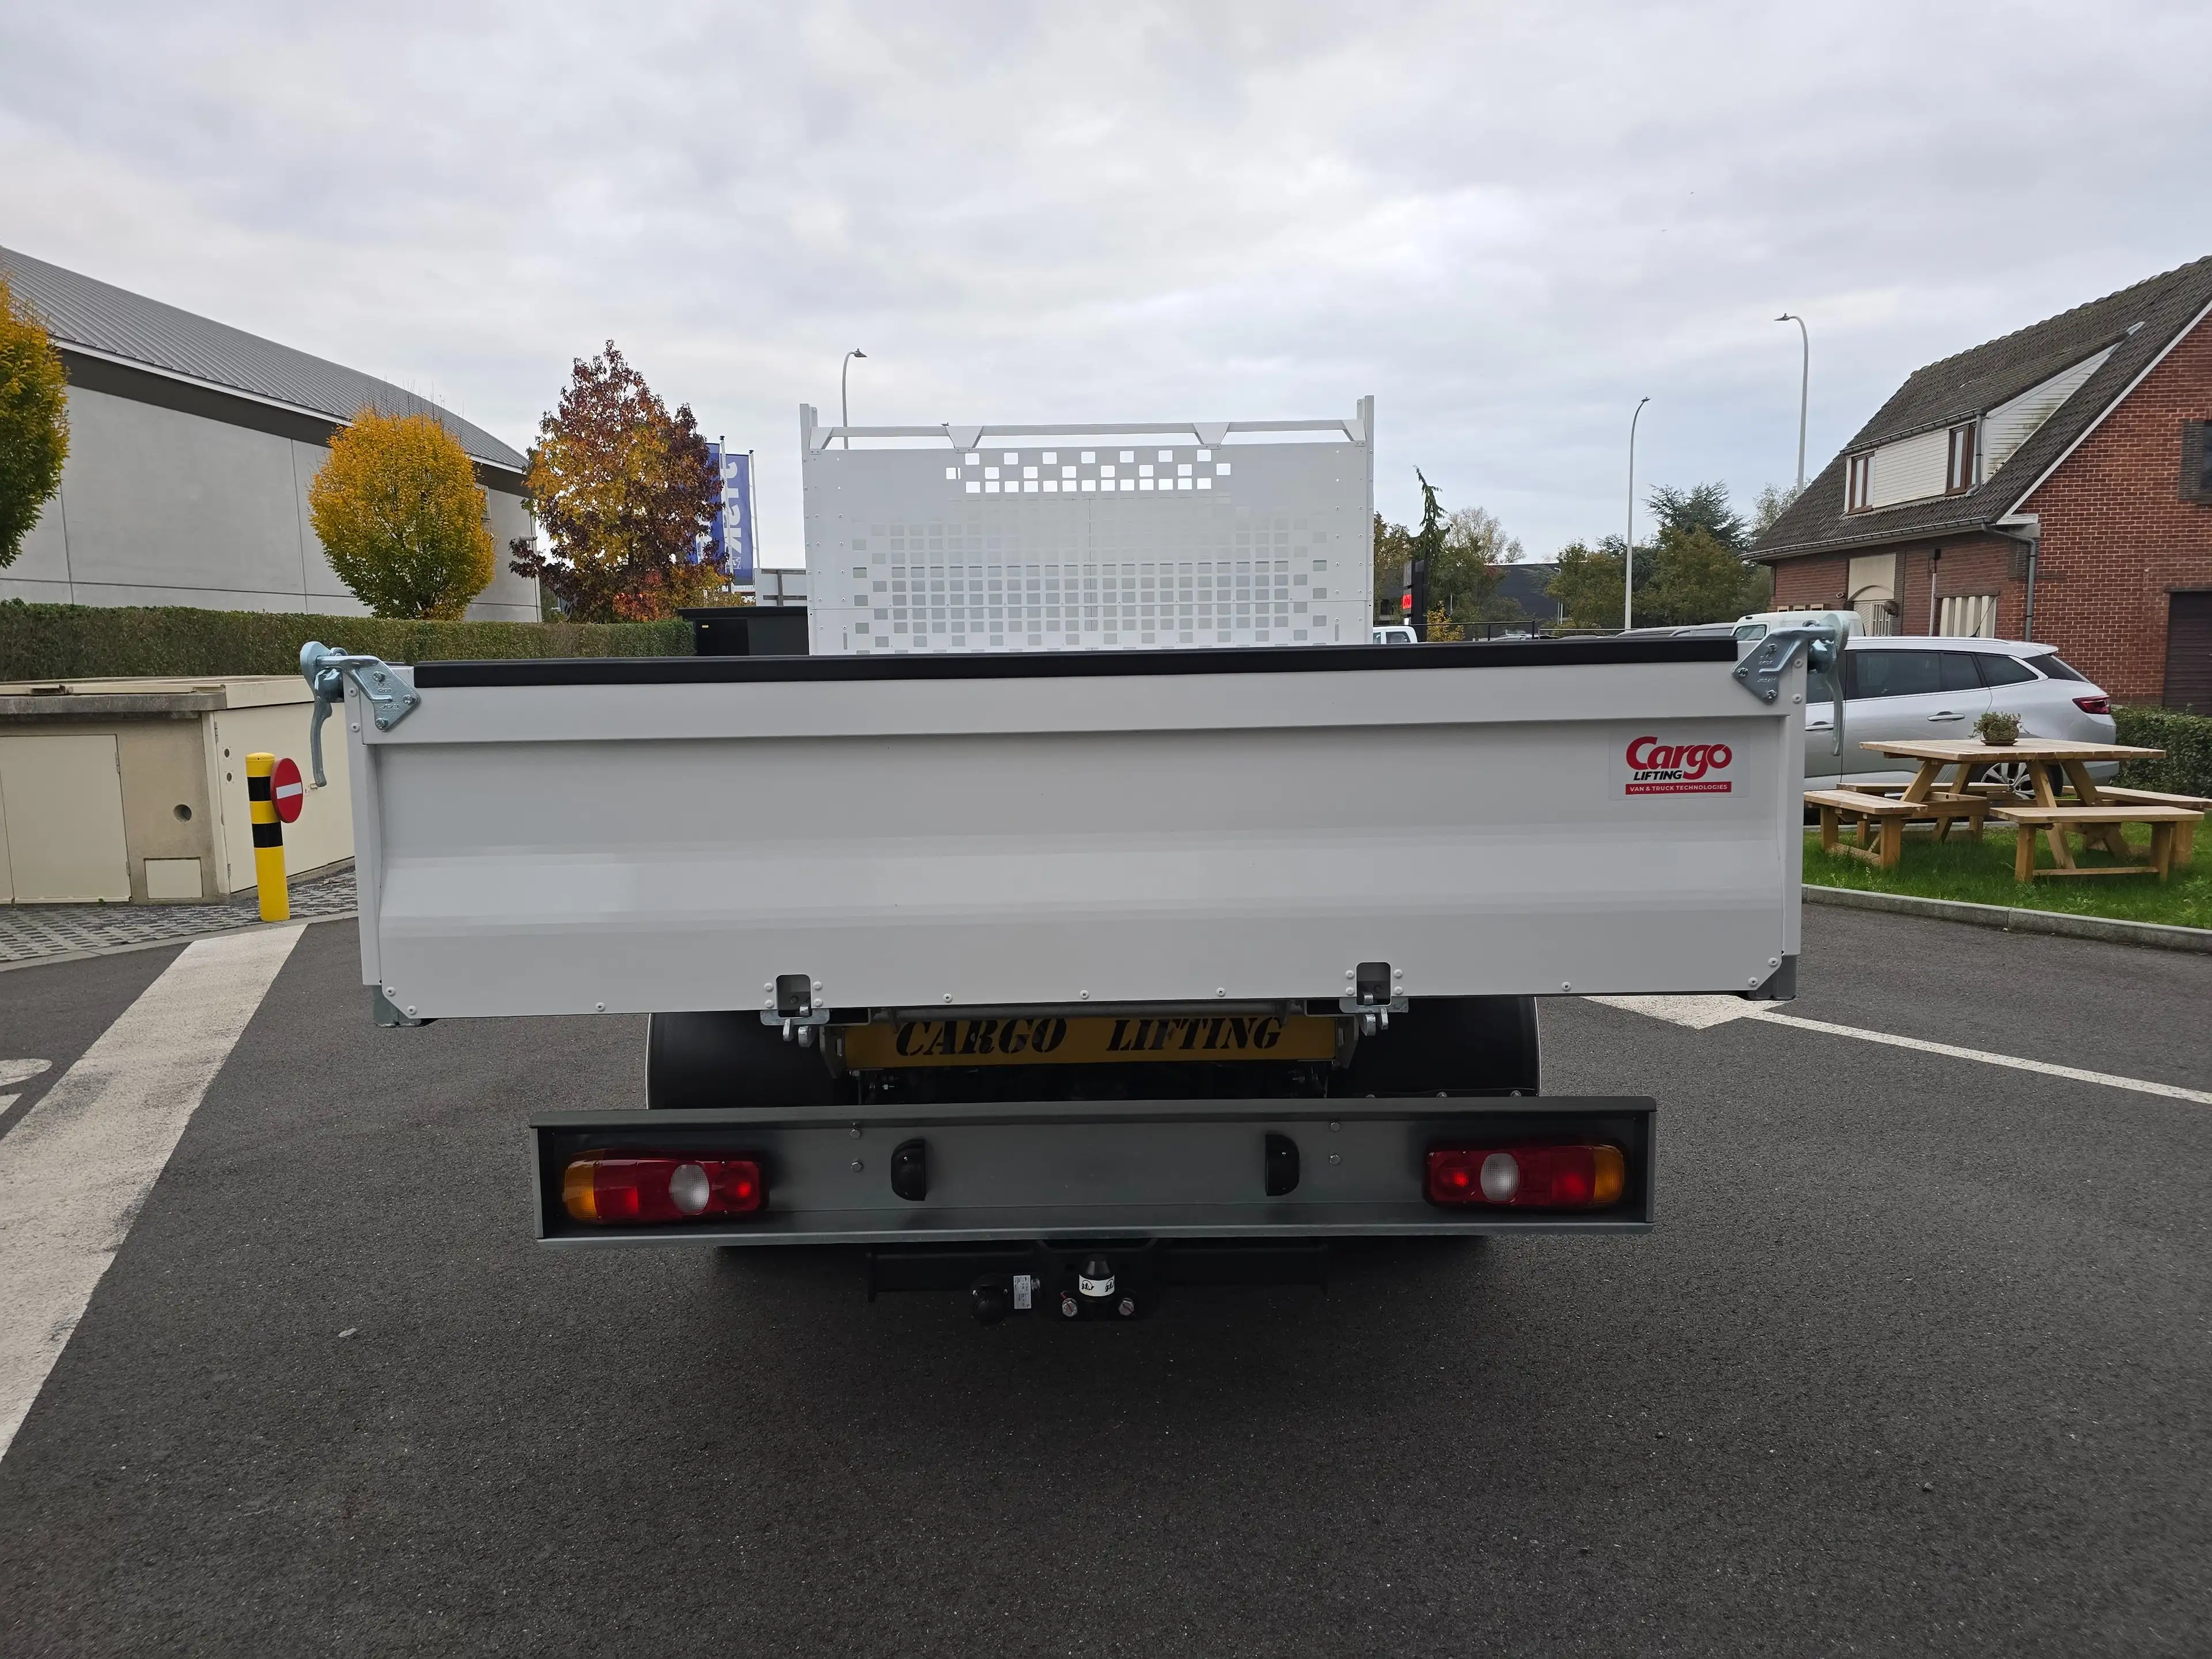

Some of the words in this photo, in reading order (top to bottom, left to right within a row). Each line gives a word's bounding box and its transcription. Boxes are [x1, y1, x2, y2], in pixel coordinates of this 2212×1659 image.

[1626, 736, 1732, 780] Cargo
[1633, 770, 1683, 781] LIFTING
[896, 1017, 1067, 1056] CARGO
[1105, 1017, 1282, 1051] LIFTING
